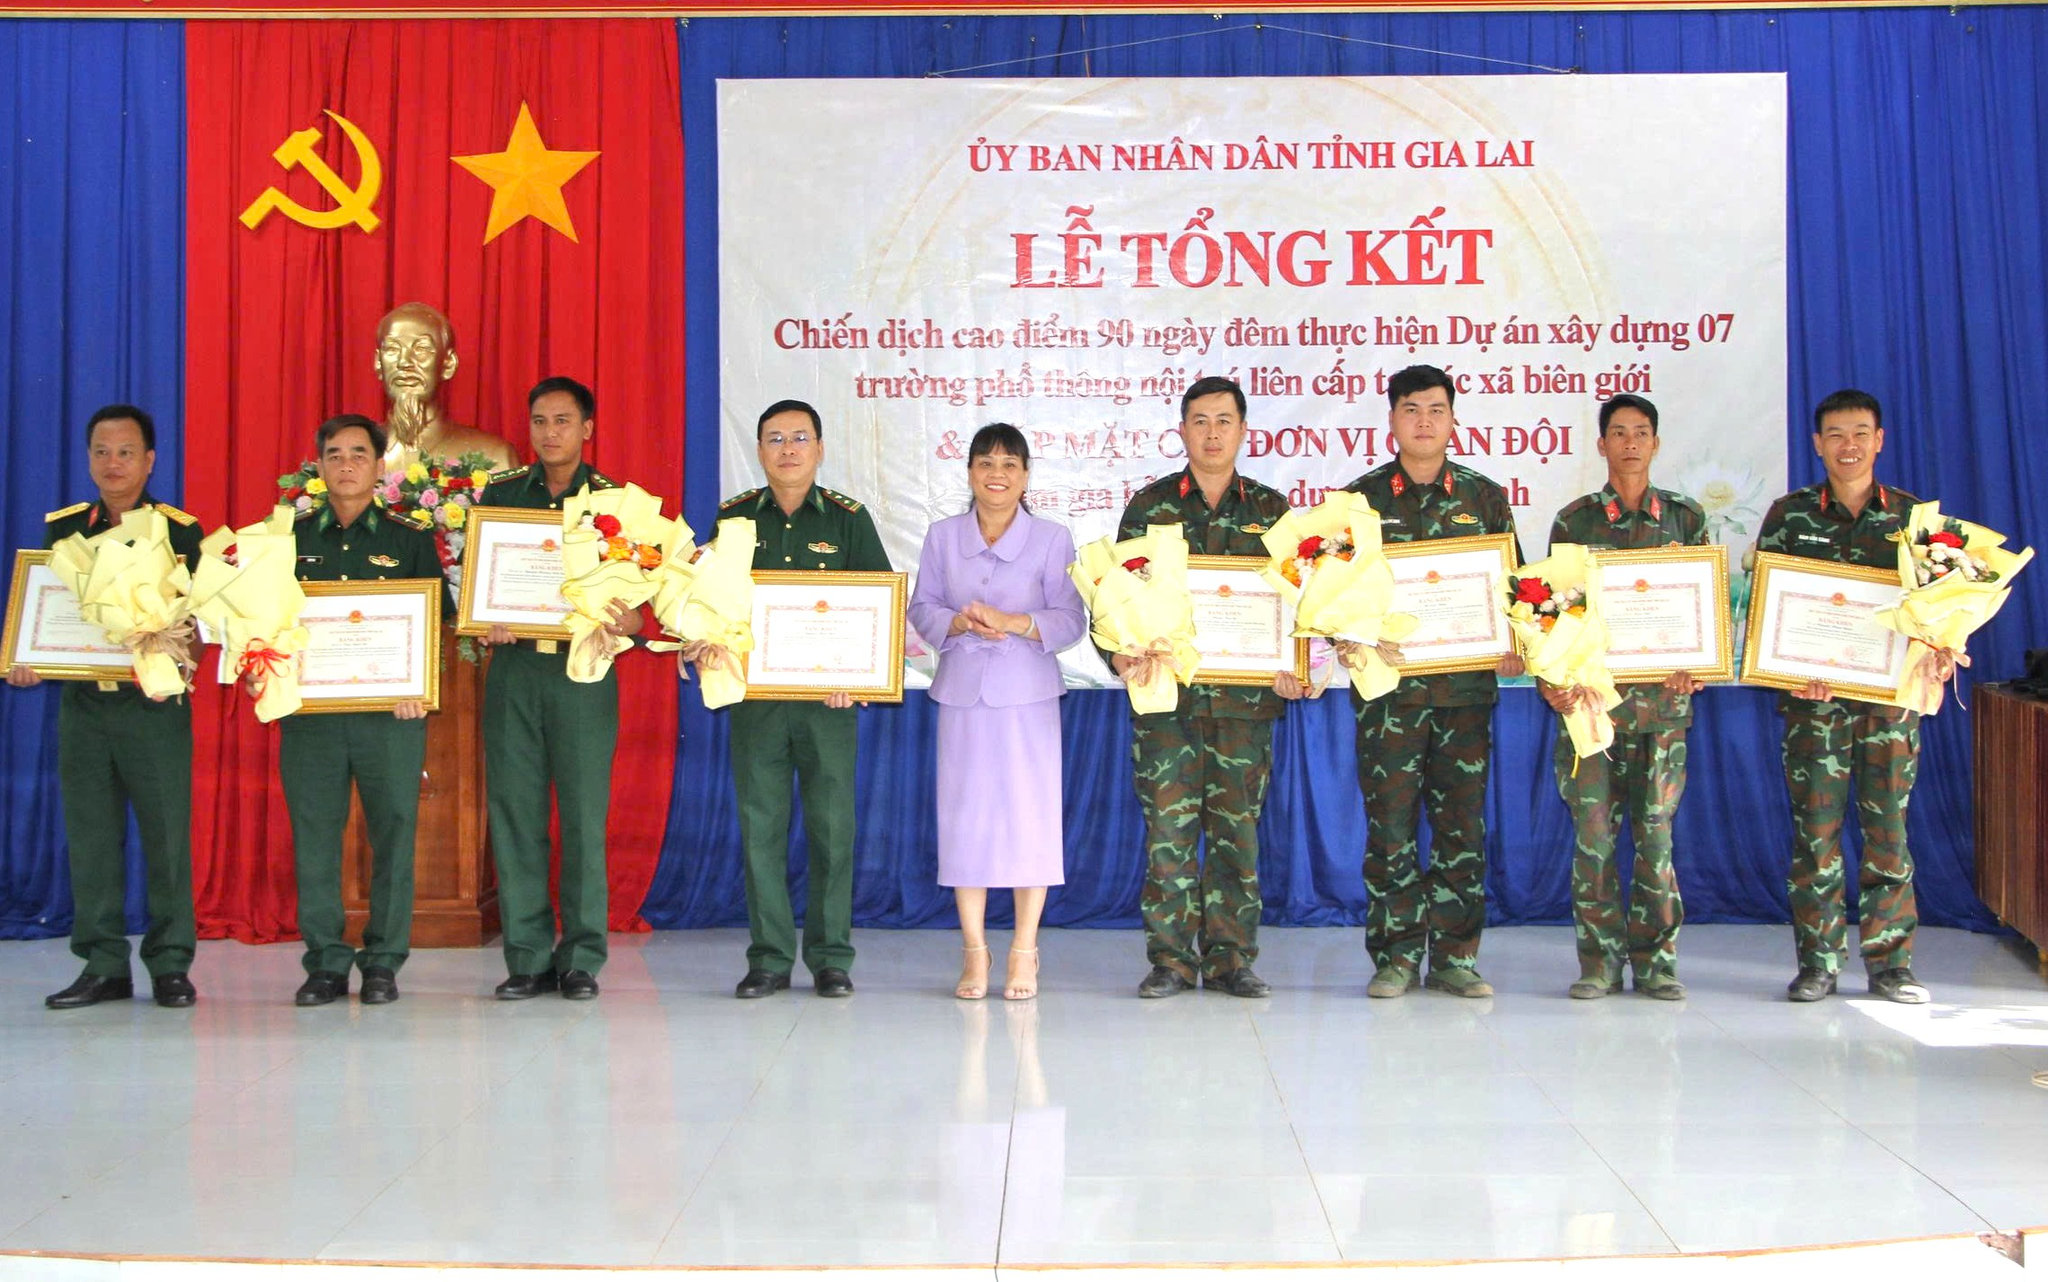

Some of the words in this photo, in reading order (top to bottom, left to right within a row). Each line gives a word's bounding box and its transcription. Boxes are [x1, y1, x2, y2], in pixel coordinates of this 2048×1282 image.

[968, 136, 1020, 172] ỦY
[1028, 143, 1103, 172] BAN
[1112, 135, 1214, 172] NHÂN
[1224, 134, 1299, 171] DÂN
[1307, 134, 1396, 169] TỈNH
[1404, 140, 1467, 168] GIA
[1475, 139, 1534, 168] LAI
[1009, 204, 1106, 289] LỄ
[1120, 206, 1333, 288] TỔNG
[1345, 206, 1494, 287] KẾT
[773, 312, 869, 349] Chiến
[877, 318, 943, 357] dịch
[952, 327, 1004, 349] cao
[1013, 313, 1090, 348] điểm
[1098, 319, 1134, 347] 90
[1143, 316, 1215, 356] ngày
[1224, 316, 1289, 347] đêm
[1298, 317, 1367, 354] thực
[1374, 314, 1439, 353] hiện
[1449, 315, 1497, 353] Dự
[1502, 315, 1539, 345] án
[1548, 313, 1602, 352] xây
[1609, 313, 1690, 352] dựng
[1697, 313, 1735, 343] 07
[855, 368, 966, 406] trường
[976, 362, 1034, 406] phổ
[1043, 367, 1132, 405] thông
[1140, 367, 1186, 404] nội
[1250, 366, 1303, 396] liên
[1312, 358, 1367, 403] cấp
[1479, 365, 1515, 395] xã
[1523, 363, 1587, 395] biên
[1594, 363, 1652, 402] giới
[935, 430, 966, 460] &
[1064, 421, 1149, 468] MẶT
[1247, 424, 1329, 458] ĐƠN
[1337, 427, 1378, 466] VỊ
[1502, 418, 1573, 464] ĐỘI
